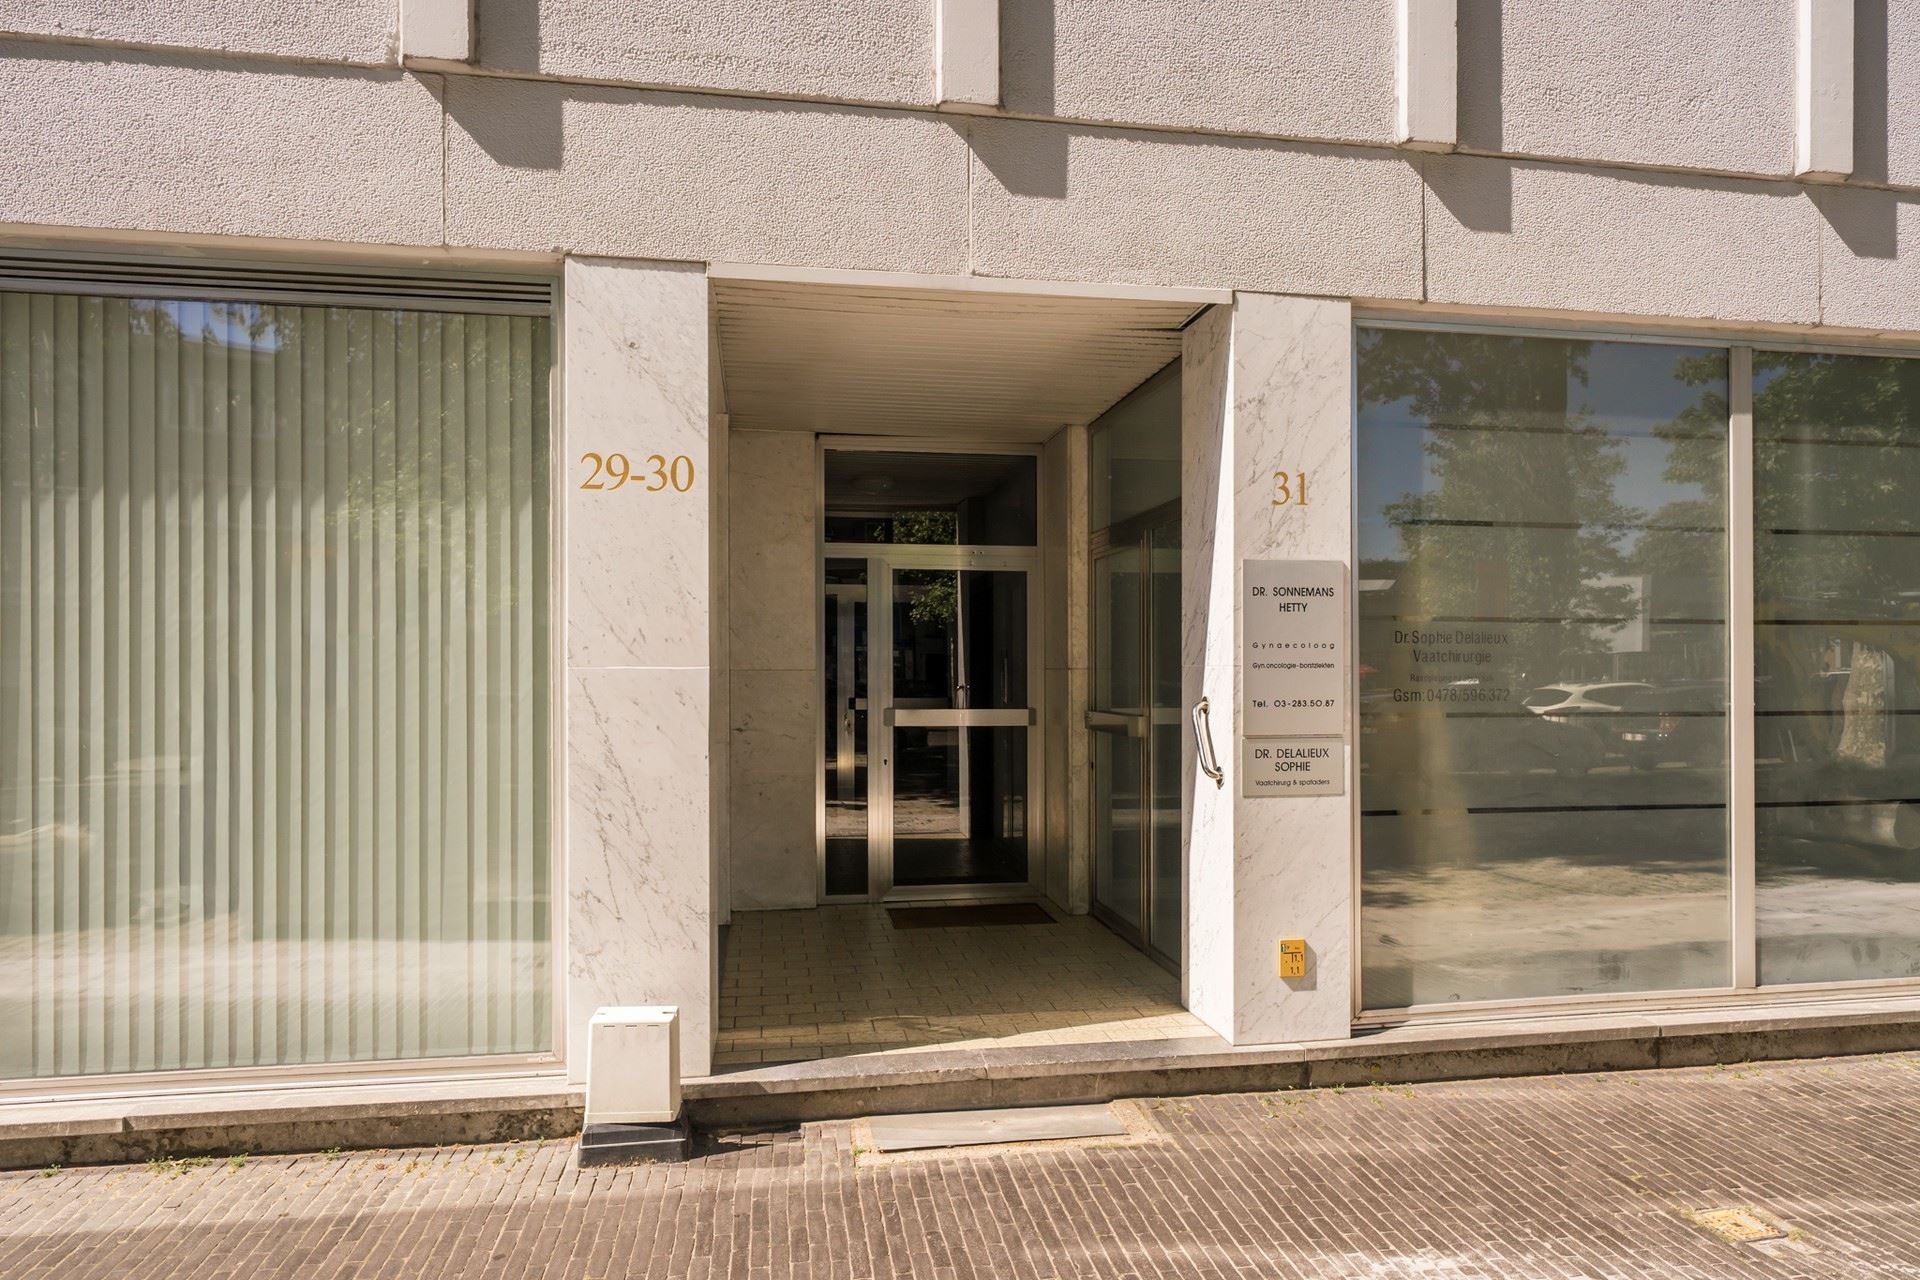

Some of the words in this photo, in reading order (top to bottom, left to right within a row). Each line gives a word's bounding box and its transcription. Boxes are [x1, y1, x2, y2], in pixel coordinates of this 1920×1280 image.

[580, 453, 695, 492] 29-30
[1272, 471, 1308, 506] 31
[1252, 586, 1268, 597] DR.
[1273, 587, 1334, 597] SONNEMANS
[1279, 603, 1308, 612] HETTY
[1252, 700, 1269, 708] Tel.
[1273, 700, 1335, 708] 03-283.50.87
[1255, 749, 1272, 759] DR.
[1276, 748, 1329, 758] DELALIEUX
[1274, 762, 1311, 772] SOPHIE
